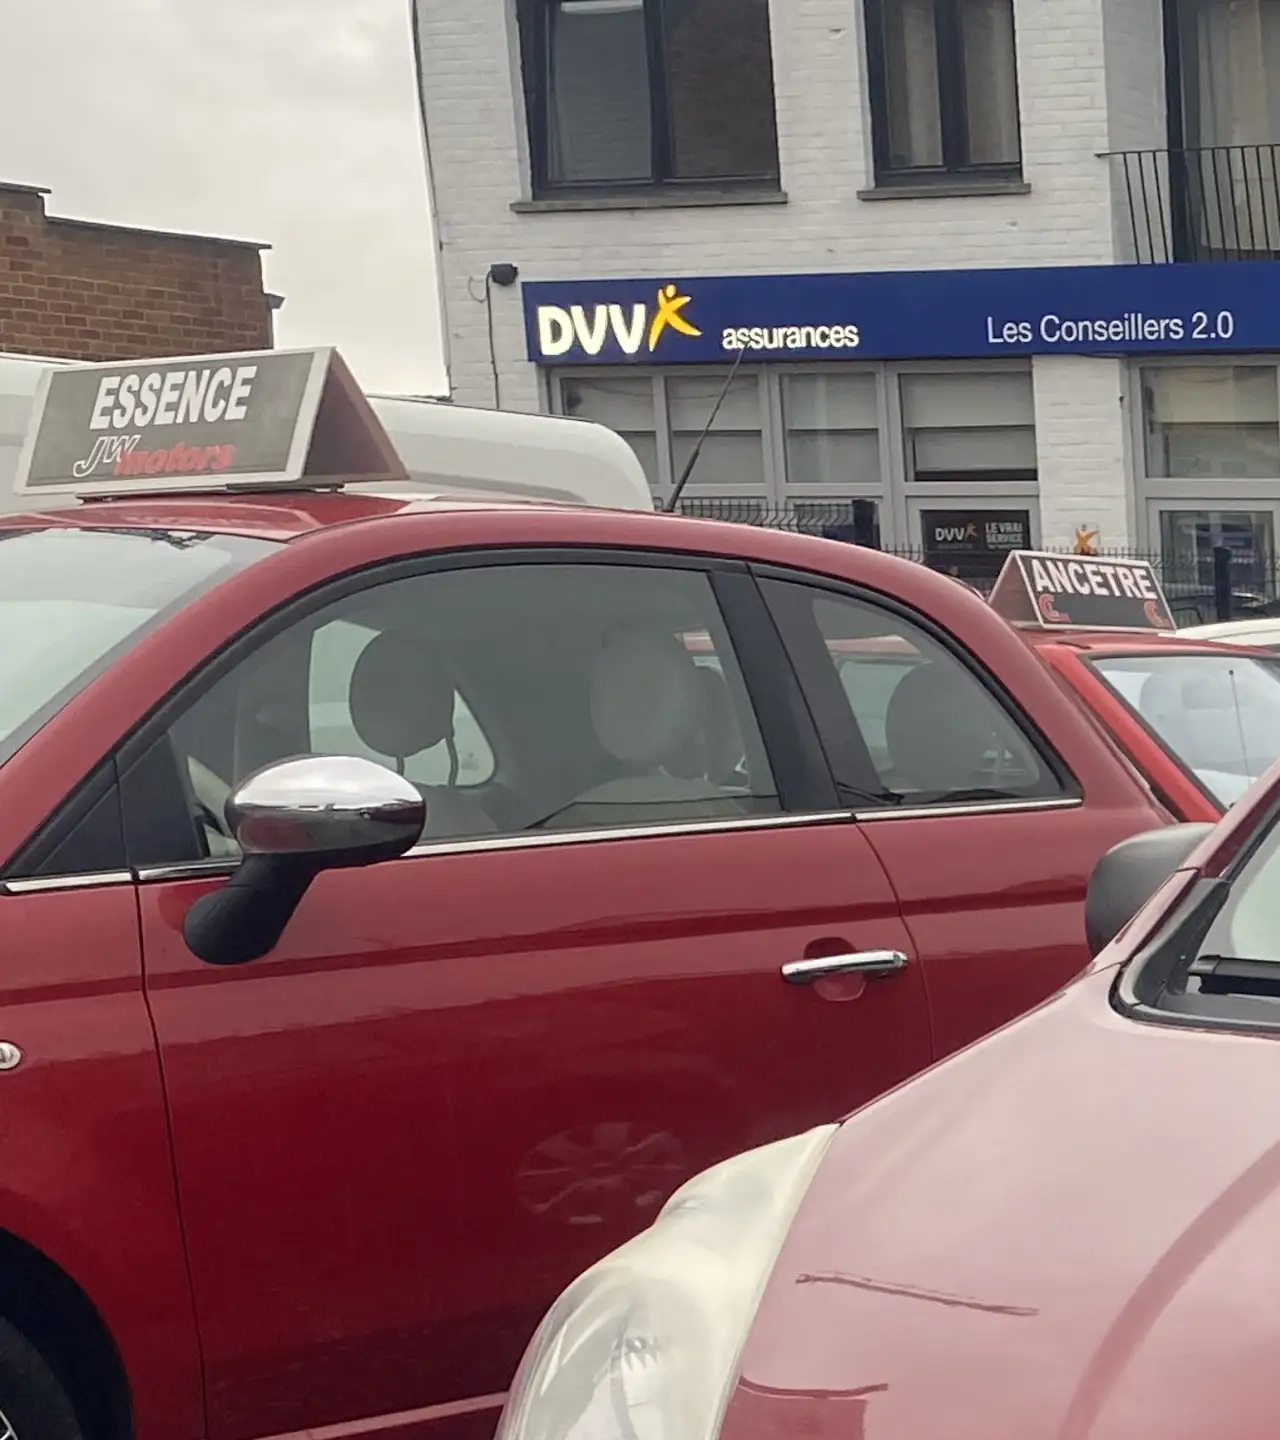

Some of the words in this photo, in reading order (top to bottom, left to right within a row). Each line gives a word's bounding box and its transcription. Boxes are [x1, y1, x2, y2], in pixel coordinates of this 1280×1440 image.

[537, 303, 647, 356] DVV
[721, 321, 860, 351] assurances
[986, 315, 1033, 344] Les
[1040, 311, 1184, 342] Conseillers
[1190, 311, 1234, 339] 2.0
[89, 365, 258, 430] ESSENCE
[114, 441, 237, 477] motors
[934, 526, 965, 542] DVV
[1031, 558, 1158, 600] ANCETRE
